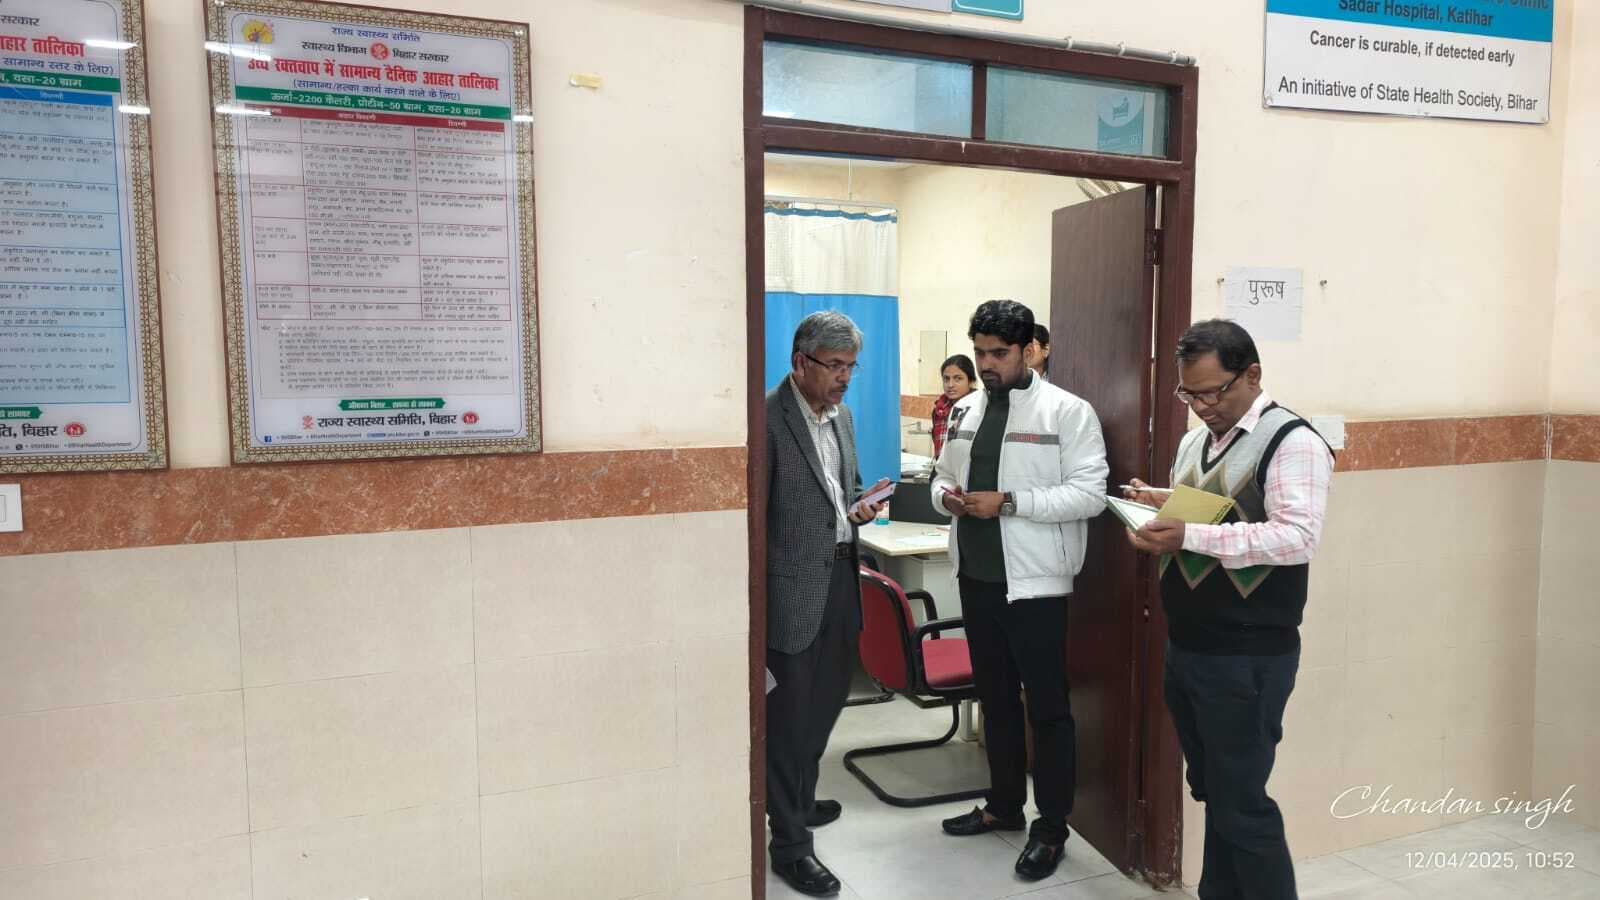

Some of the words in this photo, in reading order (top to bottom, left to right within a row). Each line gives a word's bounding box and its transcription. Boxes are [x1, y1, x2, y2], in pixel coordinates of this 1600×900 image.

[1338, 0, 1379, 14] Sadar
[1383, 0, 1443, 23] Hospital,
[1447, 8, 1494, 27] Katihar
[31, 36, 85, 57] तालिका
[1309, 30, 1356, 49] Cancer
[1359, 36, 1370, 50] is
[1373, 39, 1421, 57] curable,
[1425, 41, 1433, 56] if
[1436, 43, 1485, 61] detected
[1488, 49, 1515, 67] early
[2, 56, 45, 68] सामान्य
[48, 60, 71, 71] स्तर
[419, 53, 449, 62] सरकार
[273, 58, 320, 75] रक्तचाप
[323, 58, 336, 76] में
[338, 64, 381, 81] सामान्य
[384, 64, 418, 84] दैनिक
[423, 71, 454, 87] आहार
[458, 72, 499, 90] तालिका
[1278, 76, 1298, 95] An
[1302, 78, 1357, 99] initiative
[1360, 82, 1374, 100] of
[1376, 84, 1410, 103] State
[1414, 87, 1453, 105] Health
[1457, 91, 1504, 111] Society,
[1508, 94, 1538, 111] Bihar
[22, 423, 58, 437] बिहार
[317, 416, 344, 428] राज्य
[346, 416, 385, 427] स्वास्थ्य
[387, 412, 426, 426] समिति,
[428, 412, 457, 425] बिहार
